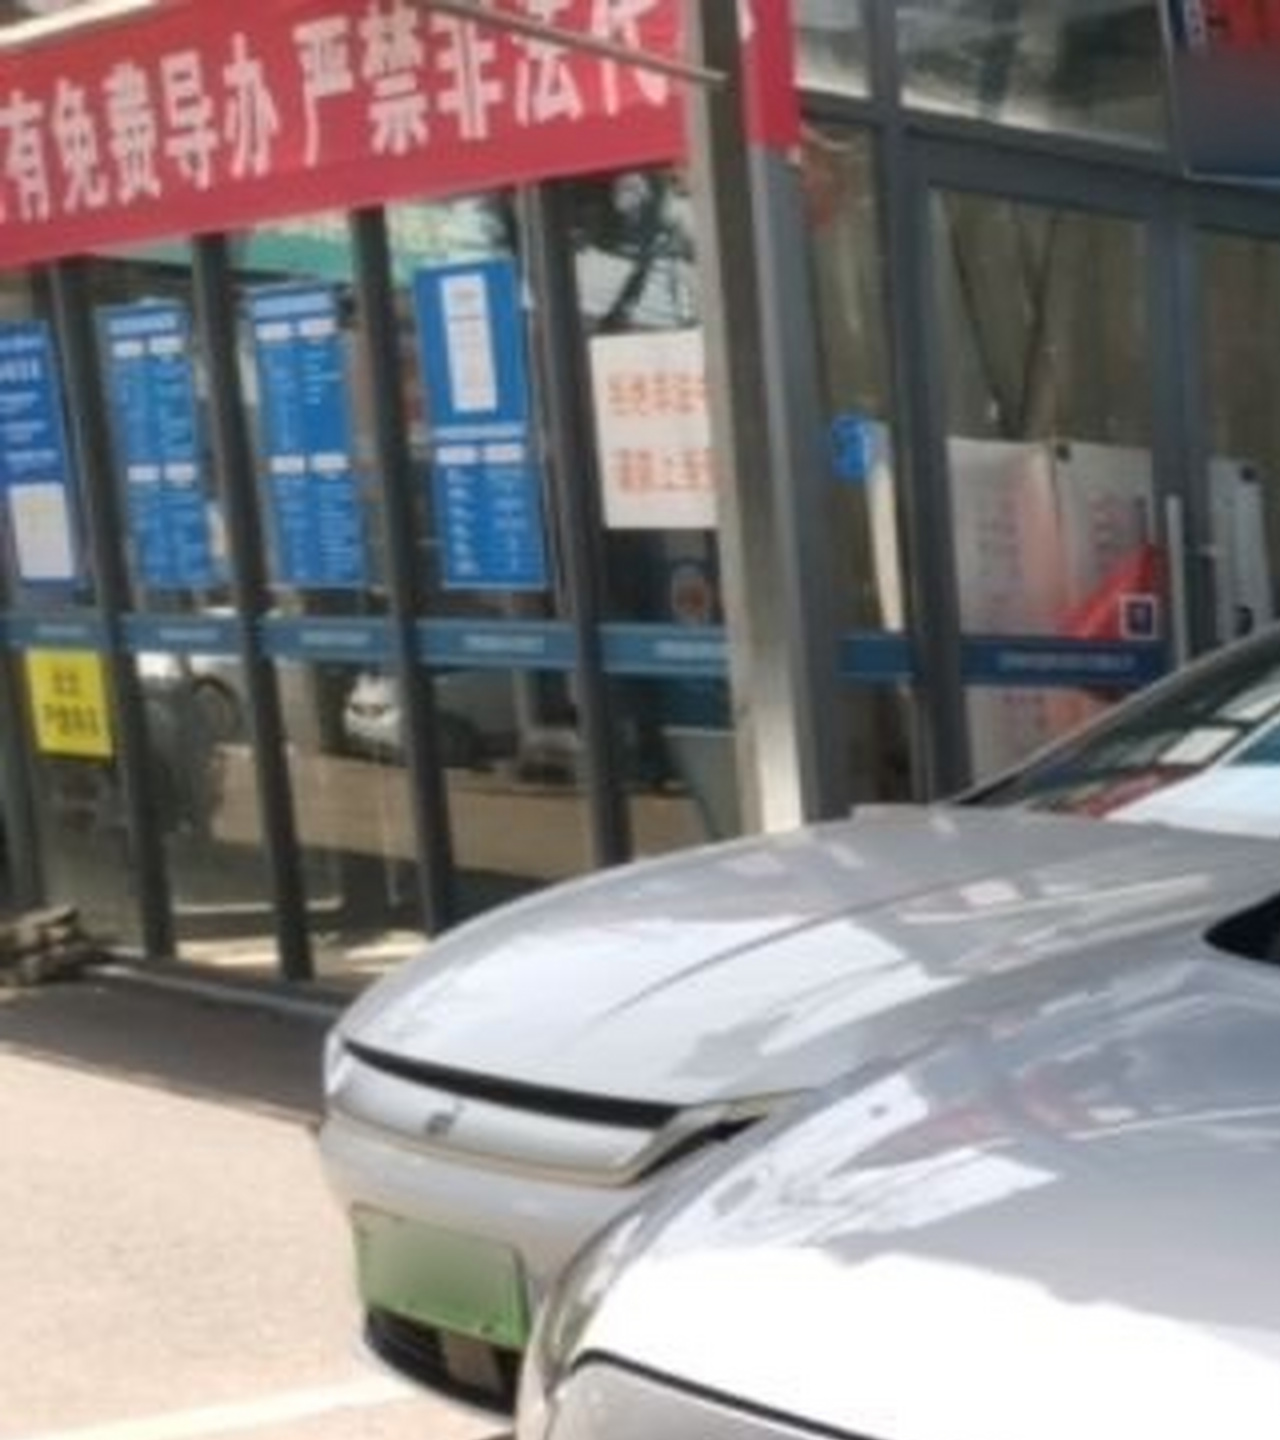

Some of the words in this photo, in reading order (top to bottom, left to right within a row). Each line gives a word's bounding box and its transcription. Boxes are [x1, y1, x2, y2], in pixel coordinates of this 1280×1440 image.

[0, 30, 281, 223] 有免费导办
[293, 0, 755, 168] 严禁非法代
